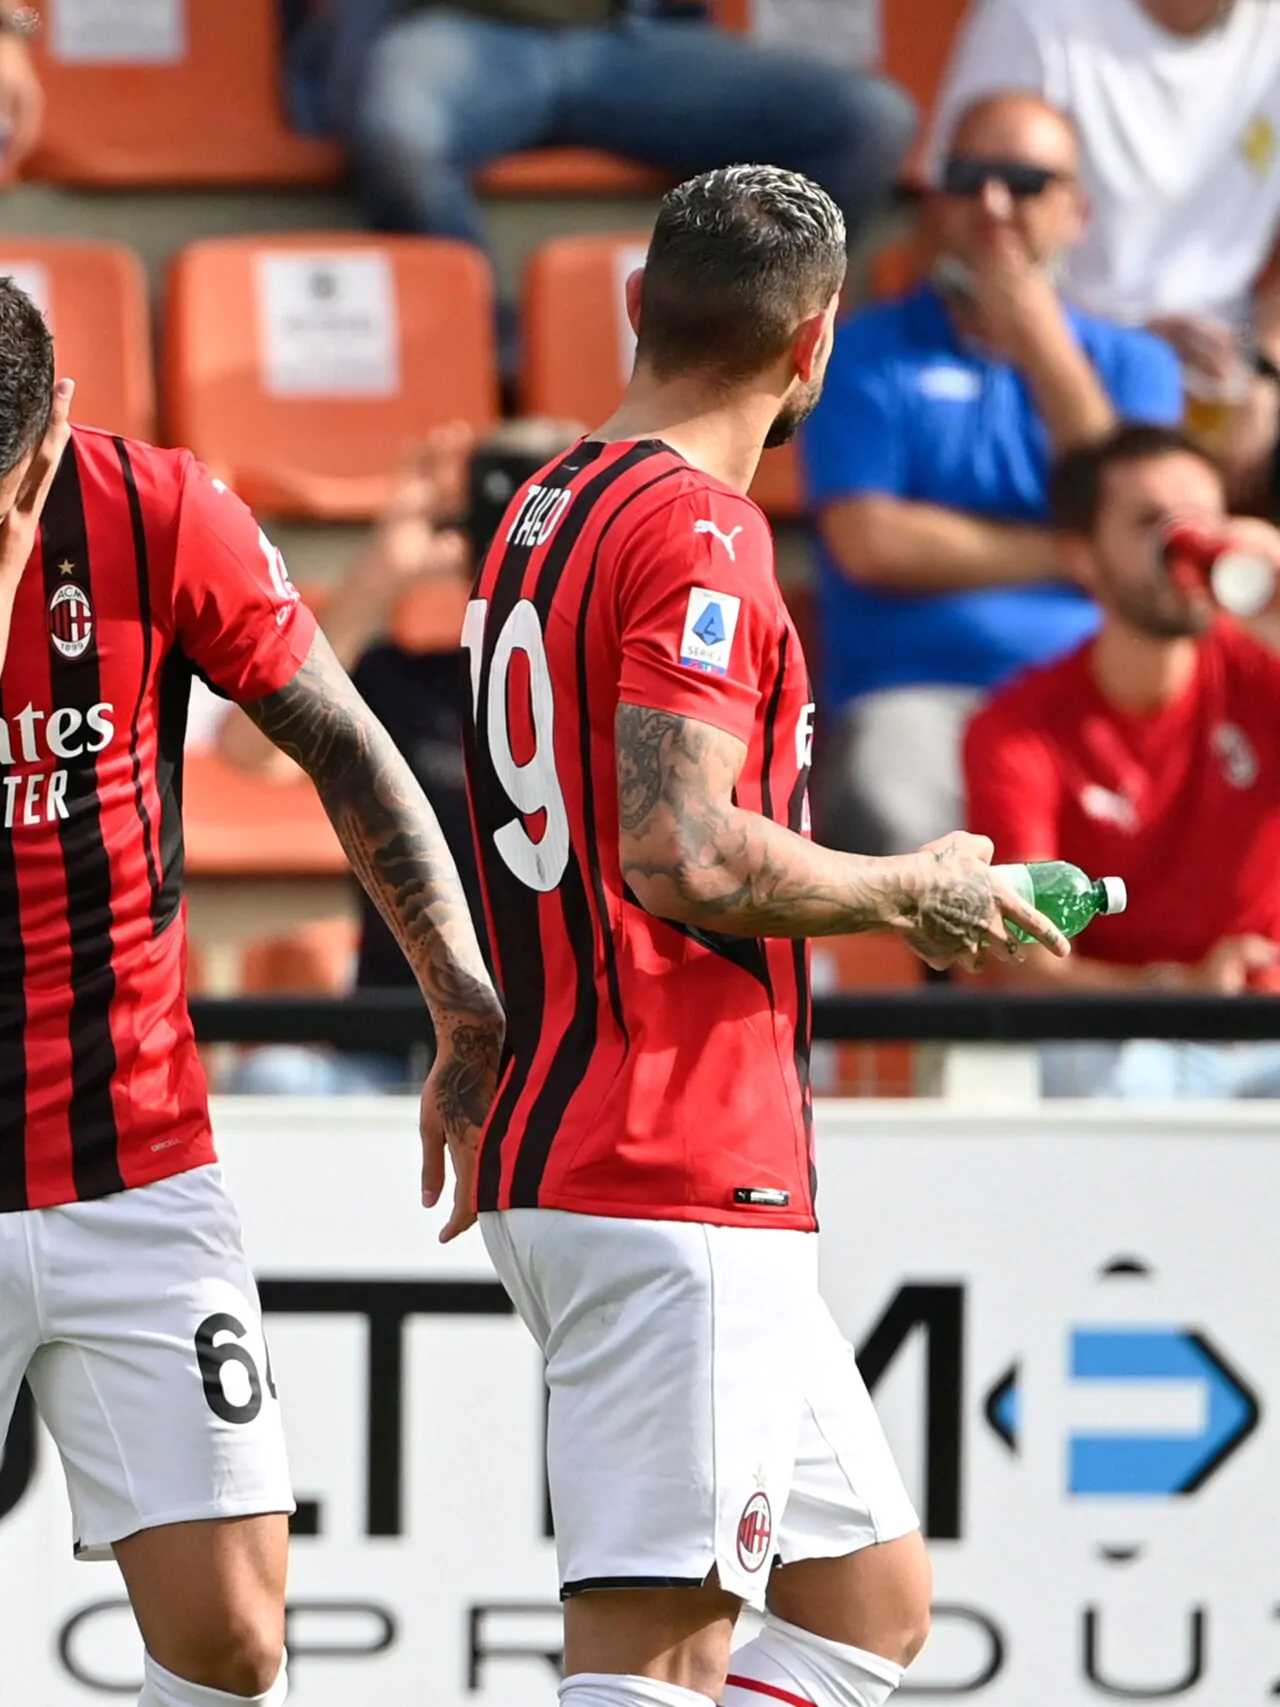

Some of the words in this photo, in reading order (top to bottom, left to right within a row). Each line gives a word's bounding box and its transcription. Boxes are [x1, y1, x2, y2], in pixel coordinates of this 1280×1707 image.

[505, 484, 572, 547] THEO
[57, 586, 84, 600] ACM
[60, 642, 84, 652] 1899
[194, 1312, 277, 1425] 6
